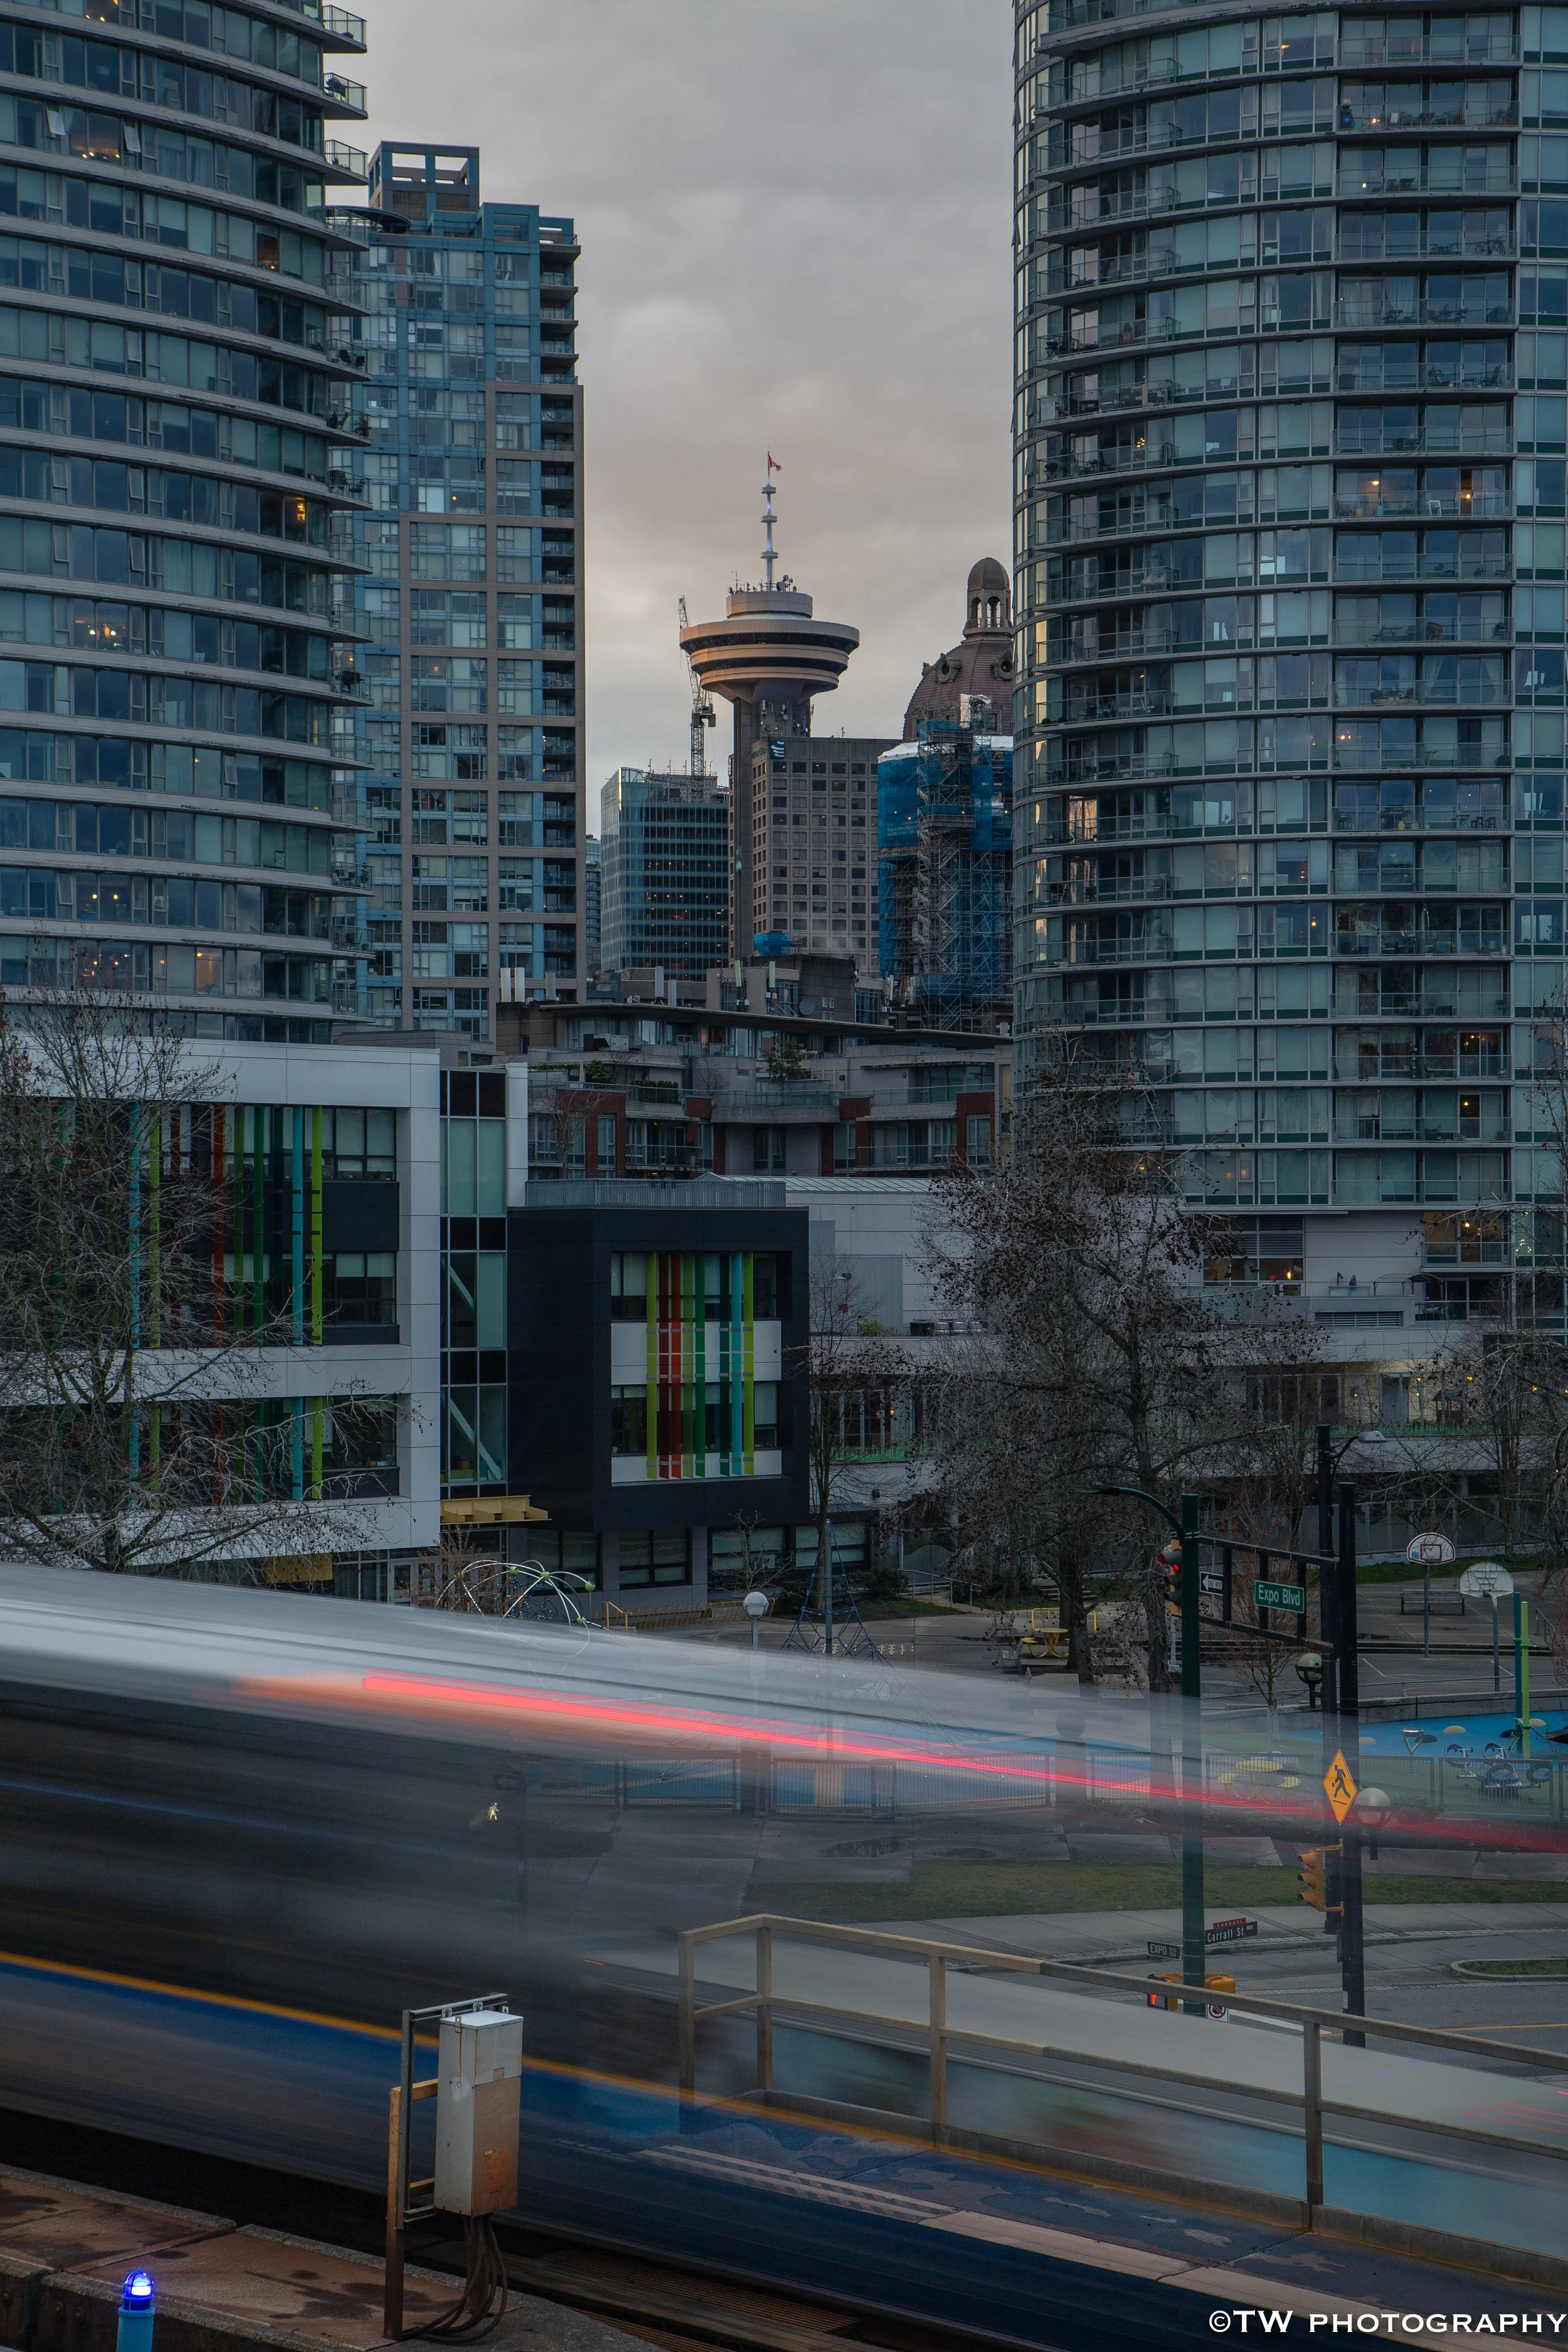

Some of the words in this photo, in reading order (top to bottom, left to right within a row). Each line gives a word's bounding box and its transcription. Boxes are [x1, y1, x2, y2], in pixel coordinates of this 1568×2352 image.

[1258, 1584, 1279, 1604] Expo
[1283, 1588, 1300, 1606] Blvd
[1217, 1919, 1242, 1928] CARRALL
[1207, 1929, 1233, 1942] Carrall
[1236, 1927, 1244, 1937] St
[1150, 1944, 1167, 1956] EXPO
